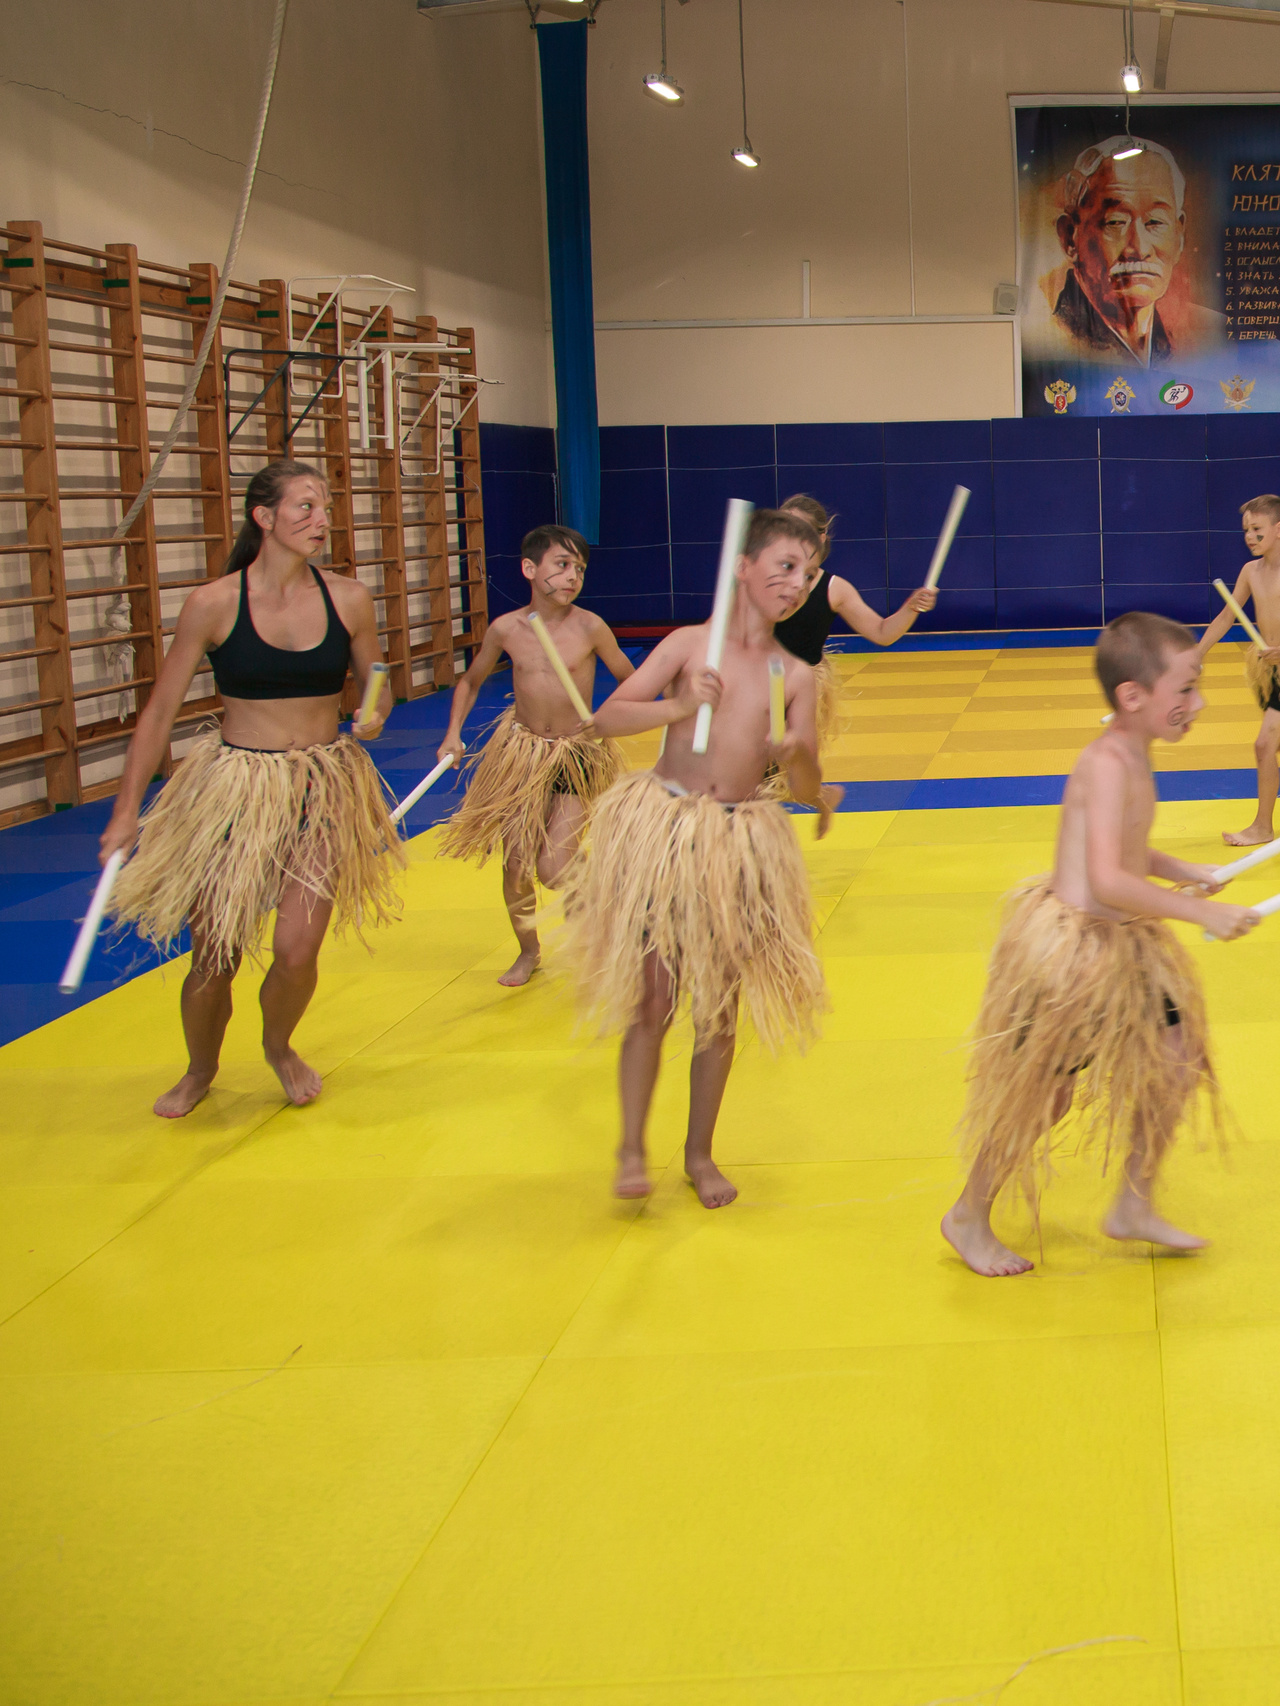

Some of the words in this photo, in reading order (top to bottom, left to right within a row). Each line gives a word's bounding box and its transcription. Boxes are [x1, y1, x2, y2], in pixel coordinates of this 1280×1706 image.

[1237, 271, 1275, 280] ЗНАТЬ
[1226, 316, 1234, 326] К
[1239, 331, 1277, 340] БЕРЕЧЬ
